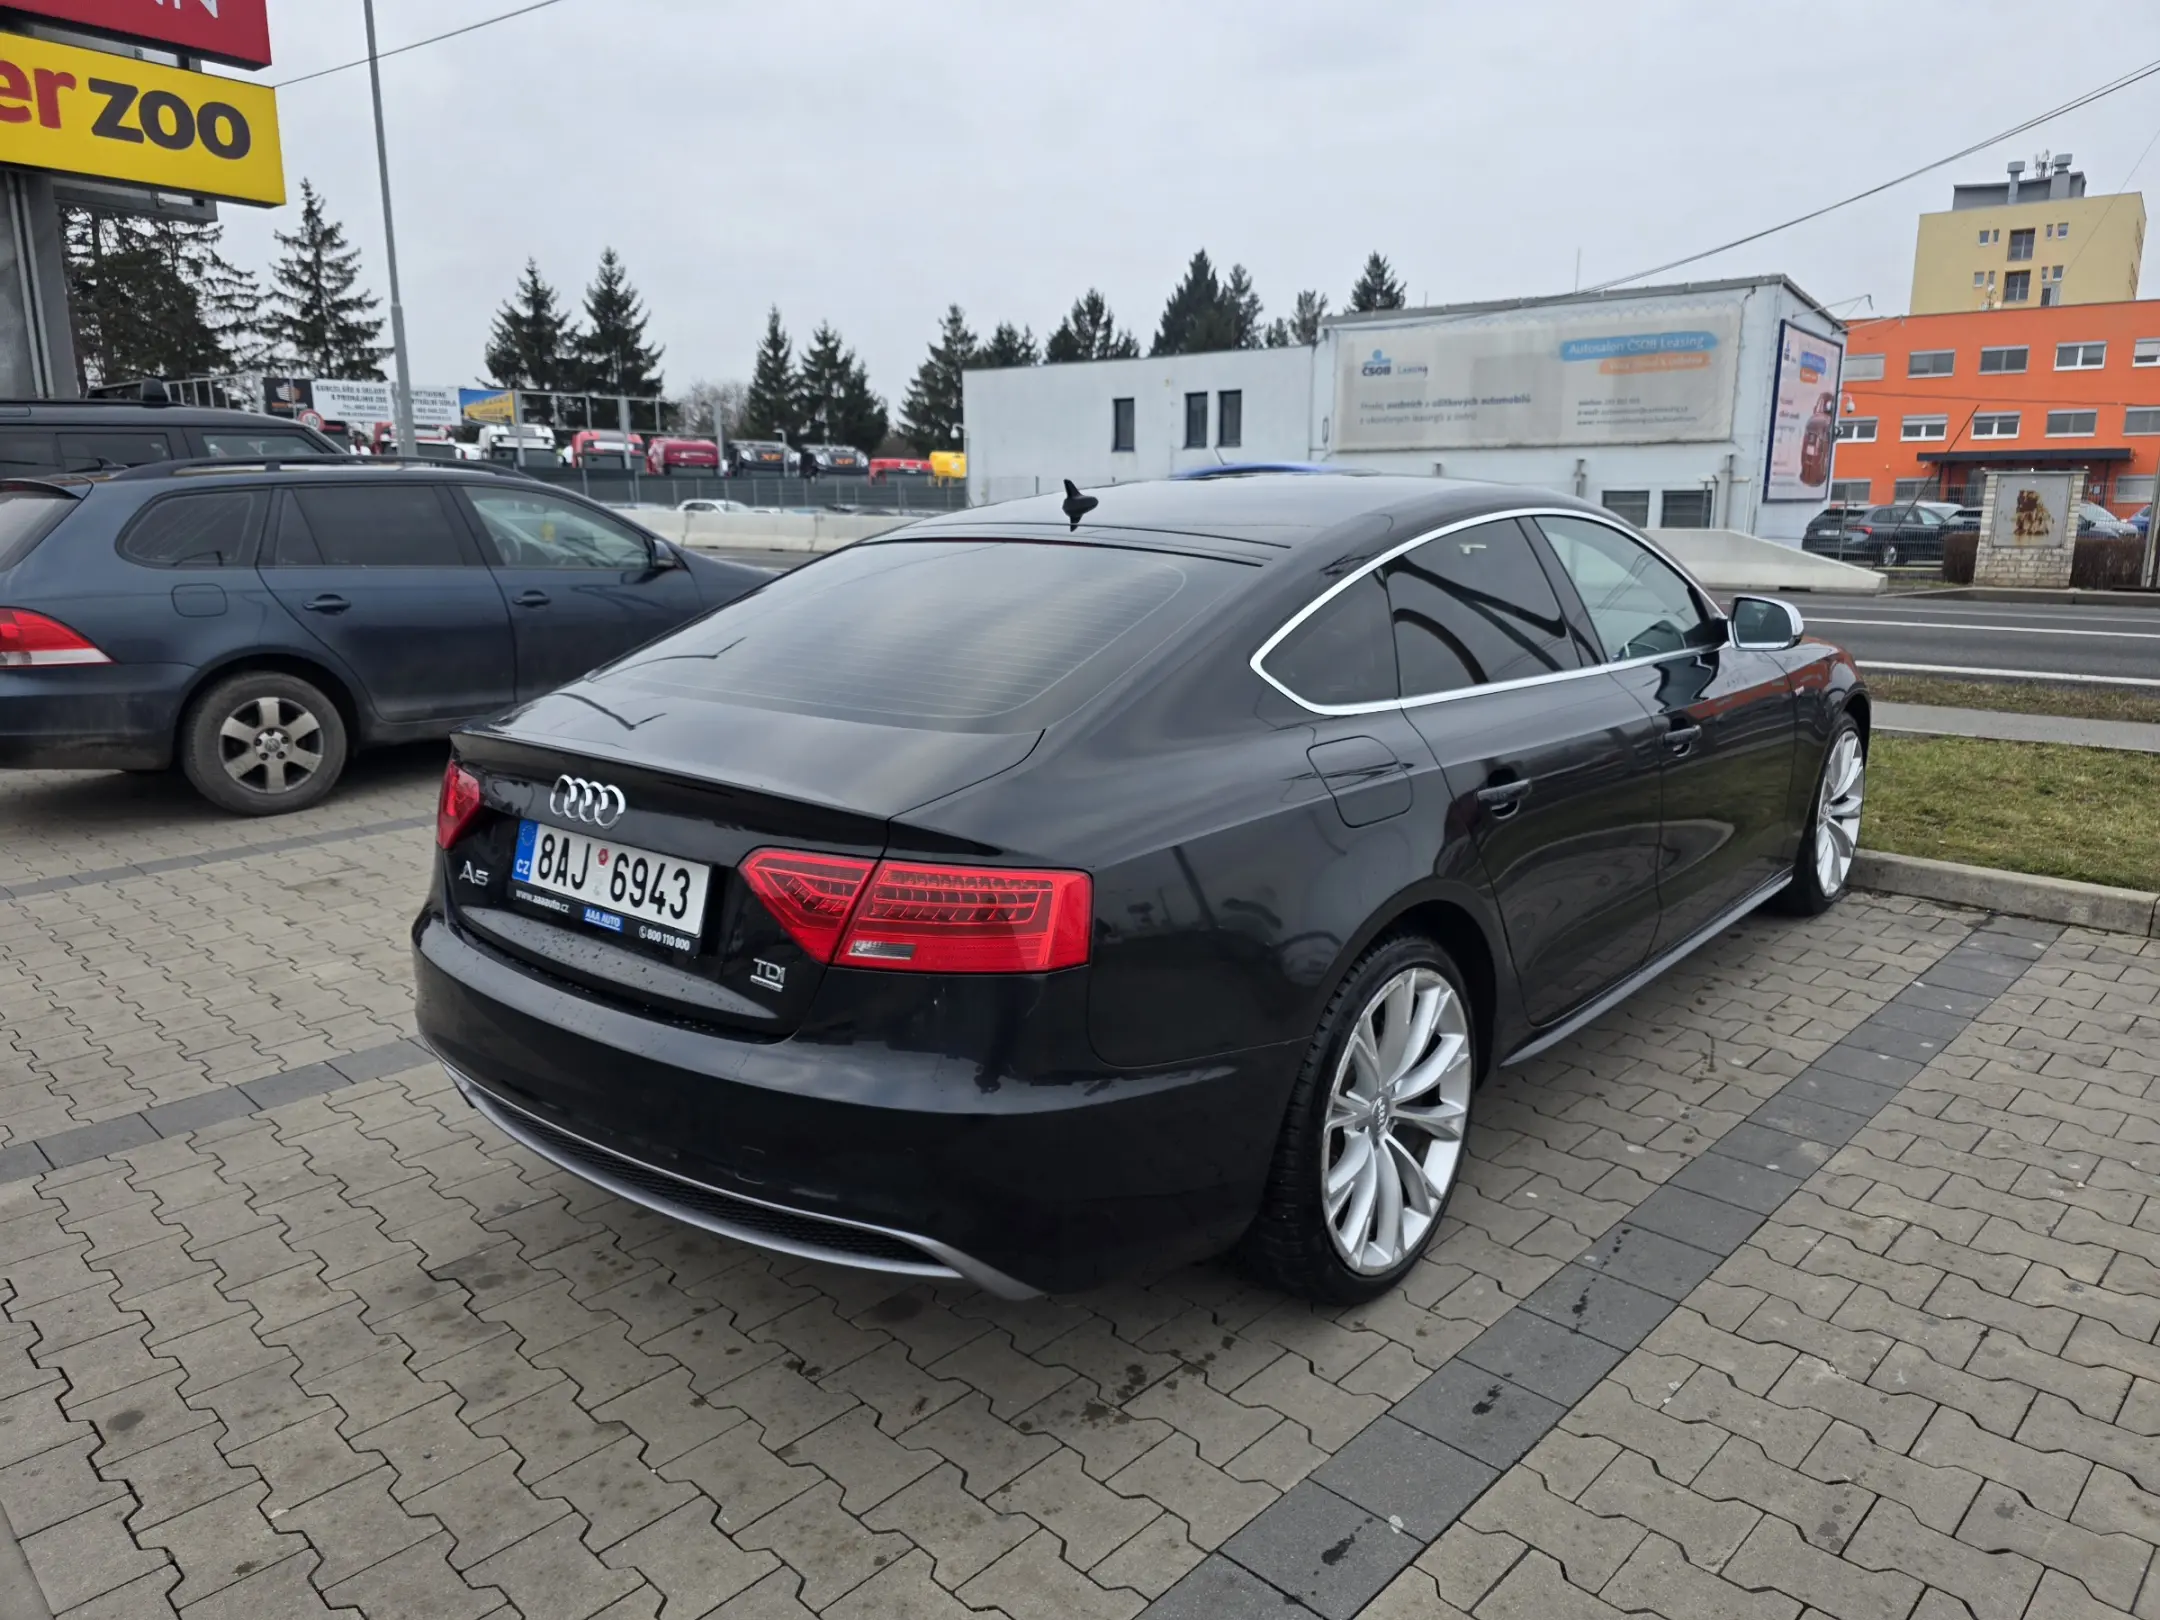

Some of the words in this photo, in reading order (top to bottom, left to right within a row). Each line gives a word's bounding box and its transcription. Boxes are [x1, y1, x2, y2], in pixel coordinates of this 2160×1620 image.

[88, 77, 251, 160] zoo
[1570, 340, 1624, 354] Autosalon
[1627, 337, 1657, 350] ČSOB
[1660, 335, 1704, 349] Leasing
[1362, 365, 1391, 376] ČSOB
[1397, 365, 1428, 378] Leasing
[459, 860, 489, 887] A5
[516, 859, 530, 875] CZ
[538, 834, 591, 890] 8AJ
[610, 852, 691, 920] 6943
[585, 908, 600, 921] AAA
[601, 913, 621, 928] AUTO
[647, 929, 662, 943] 800
[662, 933, 675, 947] 110
[675, 937, 690, 952] 800
[753, 958, 786, 984] TDI
